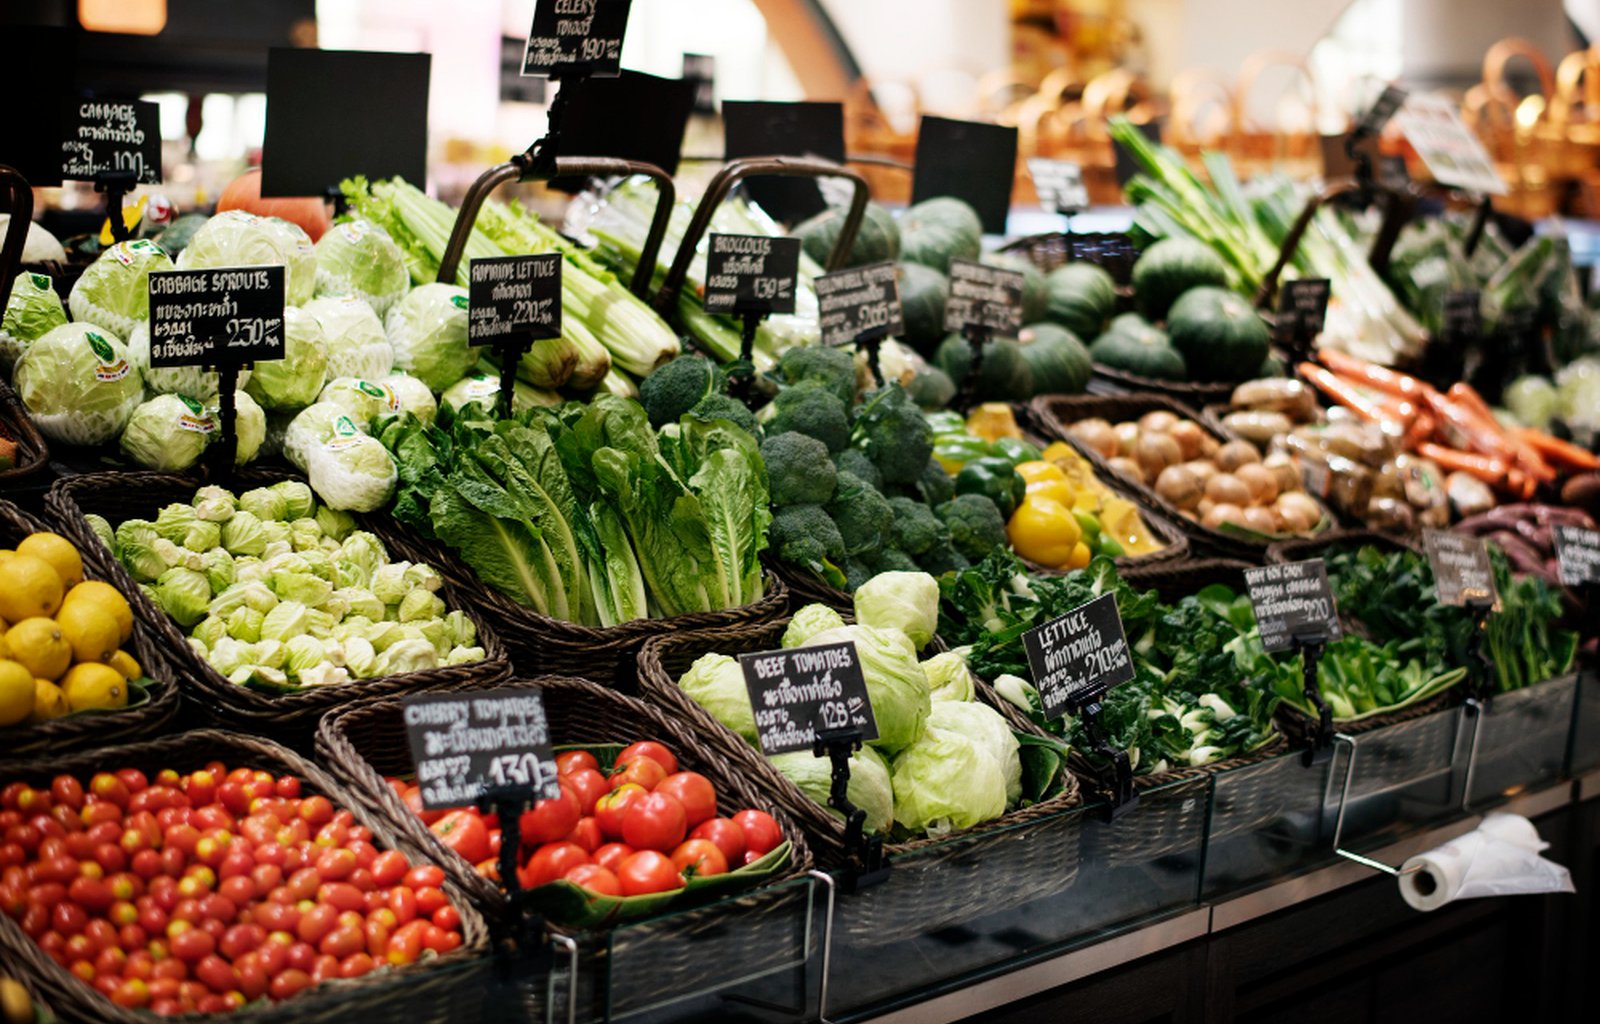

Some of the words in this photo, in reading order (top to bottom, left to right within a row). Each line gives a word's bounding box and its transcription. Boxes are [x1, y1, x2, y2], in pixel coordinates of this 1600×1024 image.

[581, 37, 606, 60] 190
[79, 102, 136, 121] CABBAGE
[516, 259, 556, 281] LETTUCE
[149, 274, 208, 295] CABBAGE
[512, 299, 538, 325] 220
[225, 317, 264, 348] 230
[1038, 611, 1089, 650] LETTUCE
[754, 655, 787, 679] BEEF
[1084, 646, 1113, 682] 210
[404, 700, 470, 727] CHERRY
[819, 700, 849, 729] 128
[488, 752, 543, 792] 130
